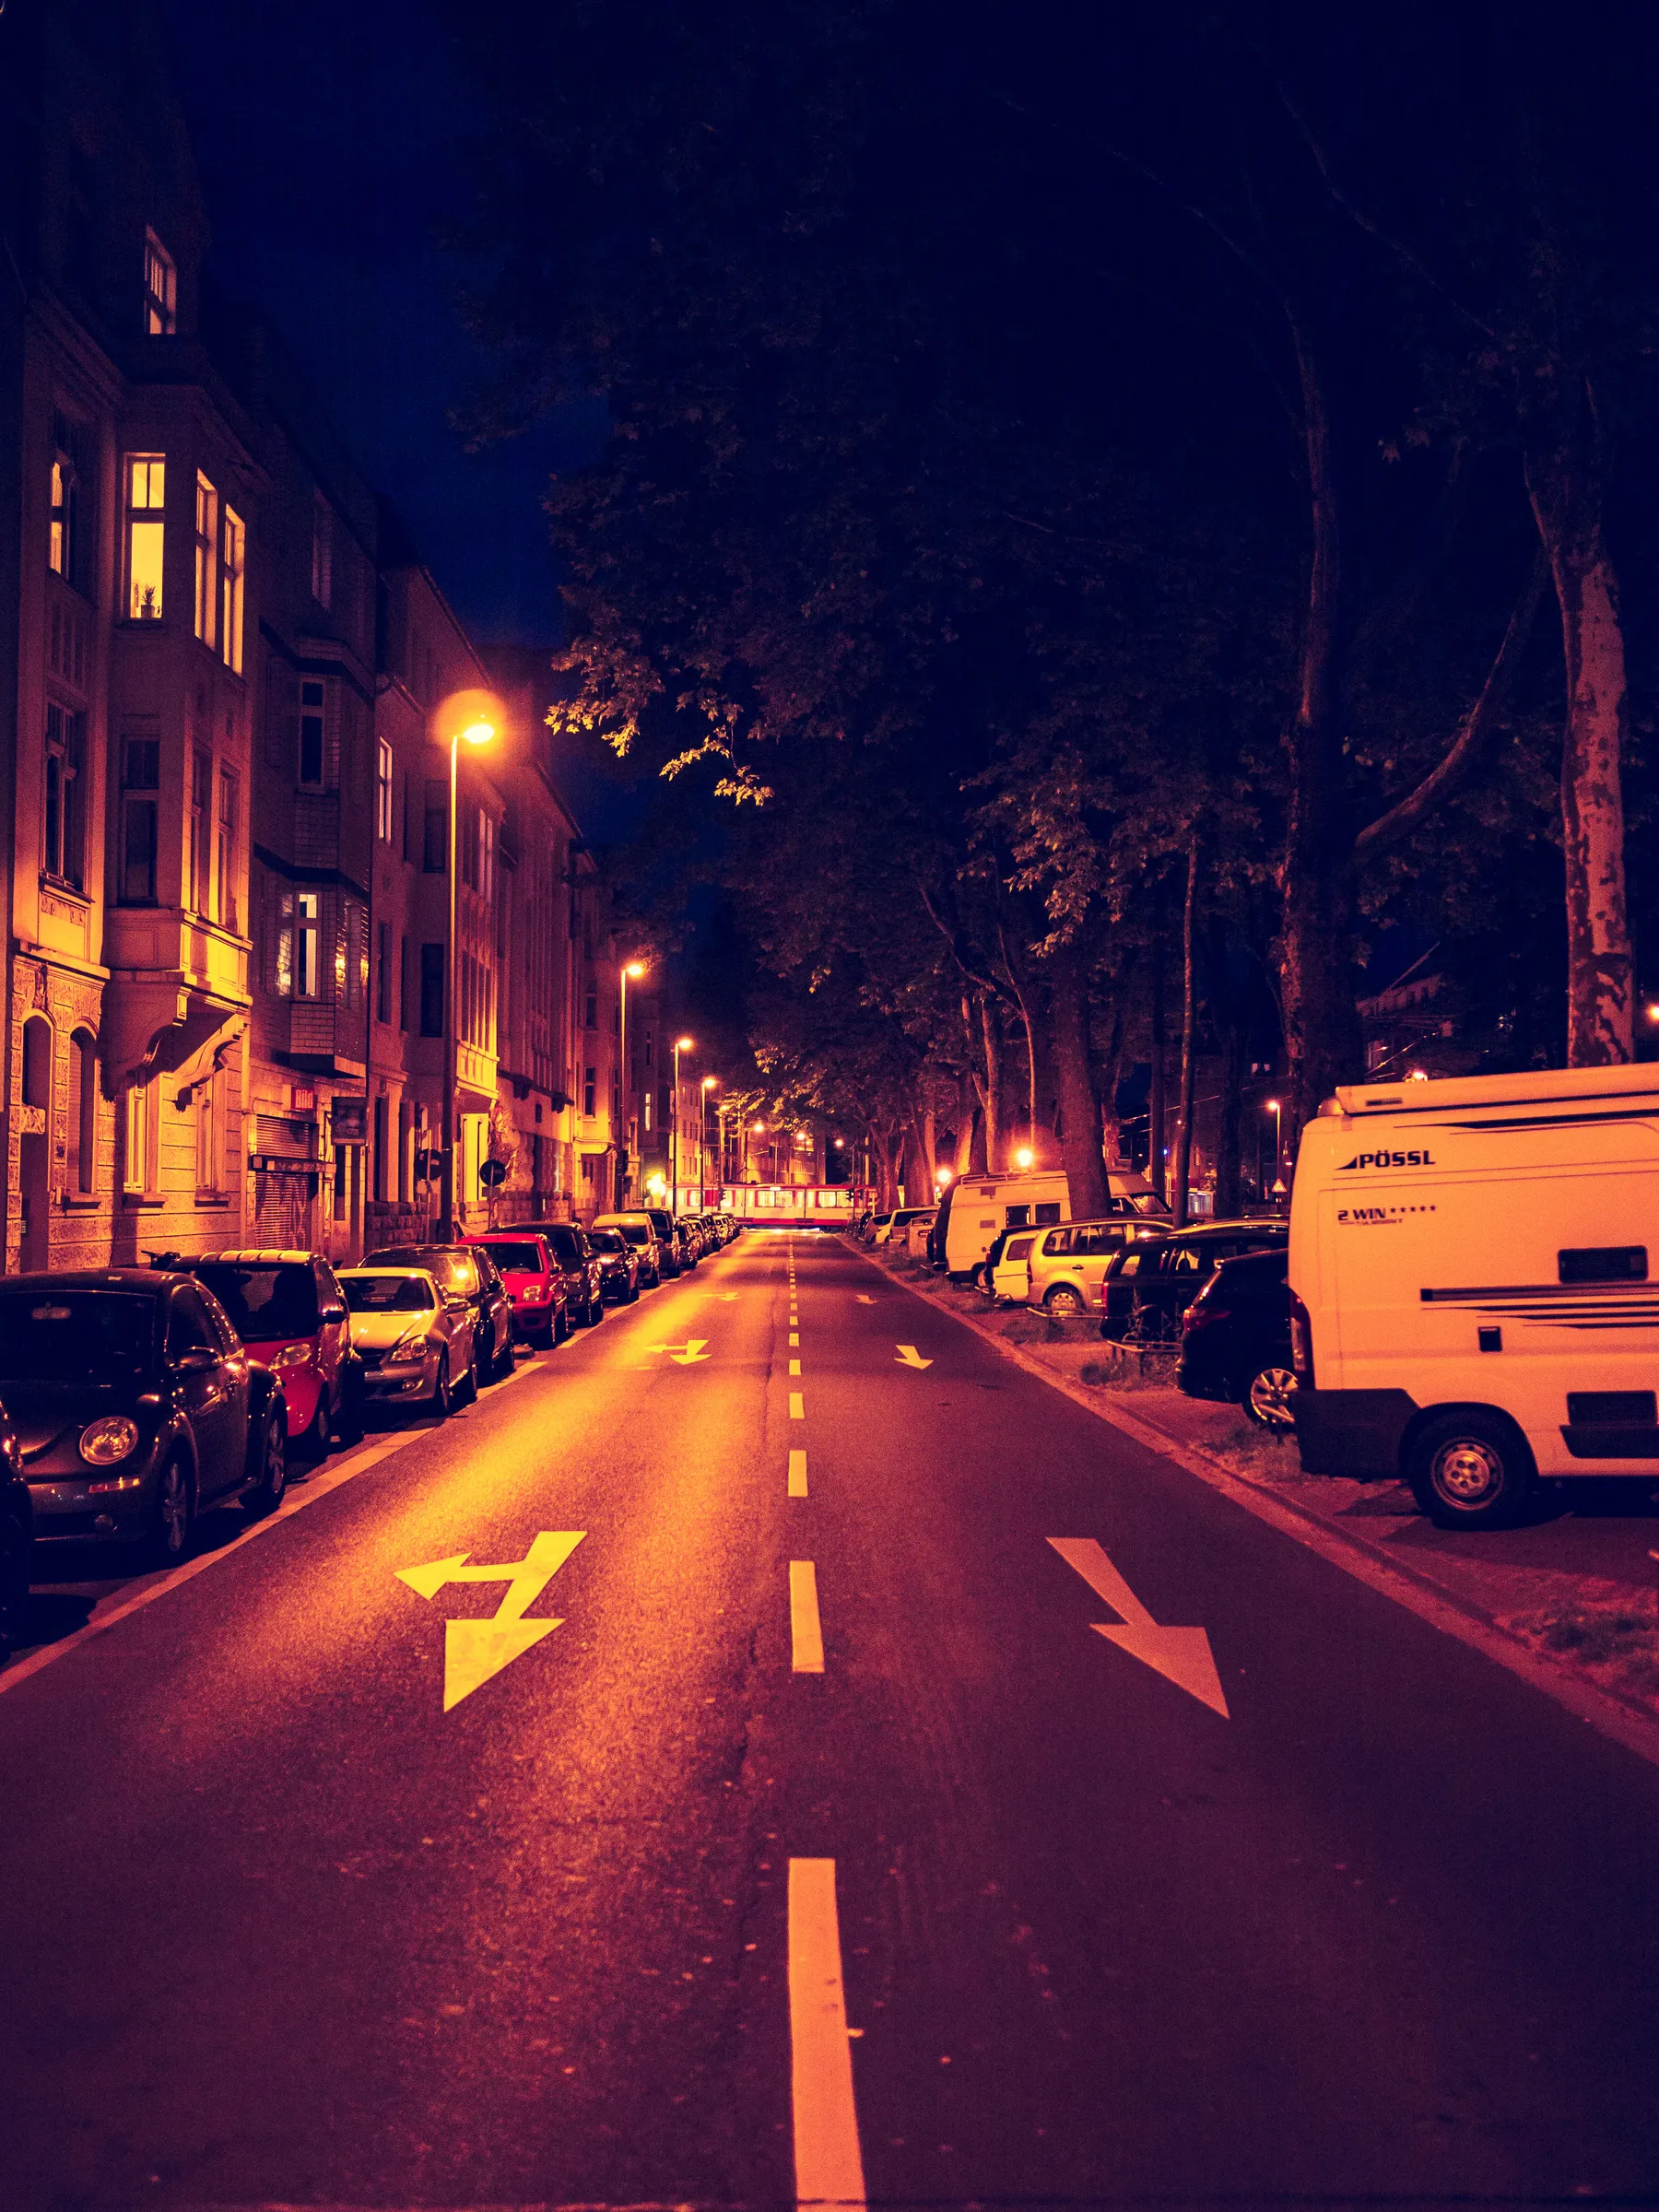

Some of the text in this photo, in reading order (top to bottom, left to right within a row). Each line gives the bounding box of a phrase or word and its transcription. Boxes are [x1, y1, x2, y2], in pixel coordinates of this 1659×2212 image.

[295, 1088, 313, 1109] Bild
[1359, 1149, 1436, 1170] PÖSSL
[1337, 1207, 1386, 1221] 2 WIN
